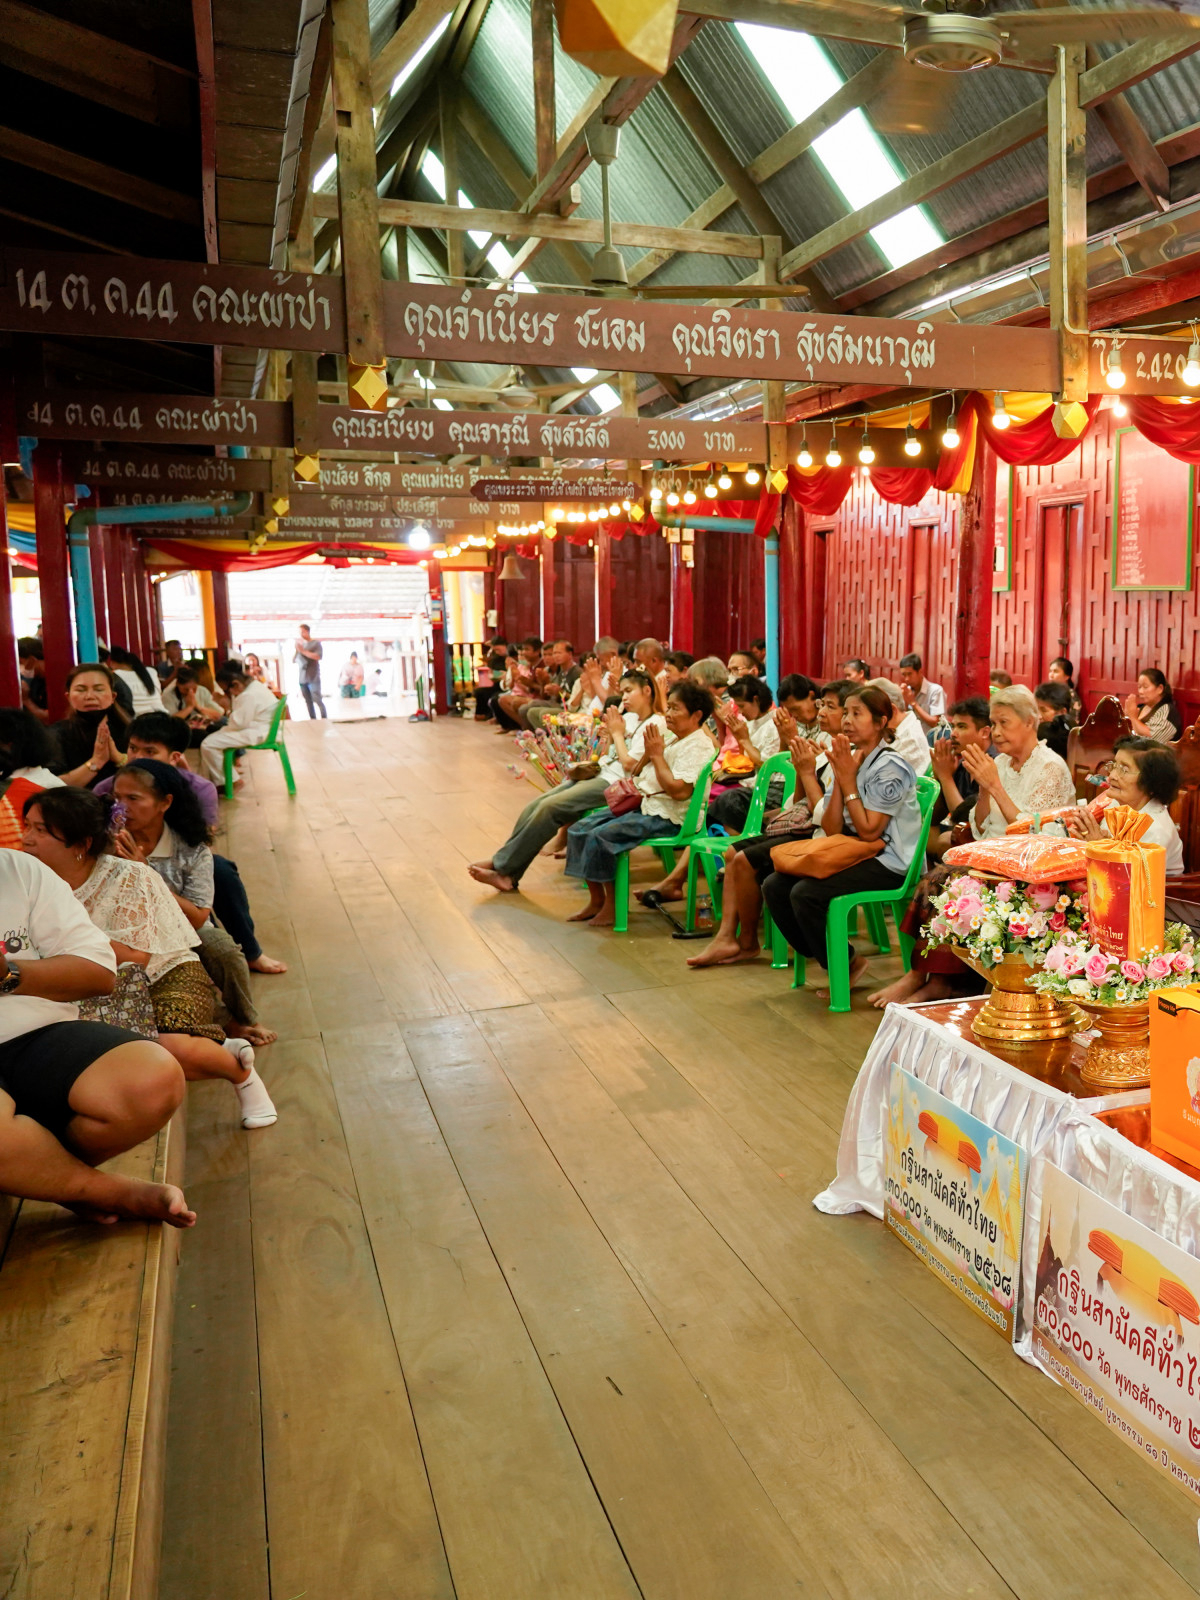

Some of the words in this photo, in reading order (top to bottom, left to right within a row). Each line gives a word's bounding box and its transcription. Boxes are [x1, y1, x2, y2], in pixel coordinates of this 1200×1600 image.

[192, 271, 332, 332] คณะผ้าป่า
[403, 289, 560, 353] คุณจำเนียร
[574, 307, 646, 353] ชะเอม
[672, 309, 781, 373] คุณจิตรา
[796, 321, 936, 386] สุขสมนาวุฒิ
[155, 398, 258, 435] คณะผ้าป่า
[332, 408, 434, 449] คุณระเบียบ
[448, 414, 530, 456] คุณจารุณี
[648, 429, 686, 451] 3,000
[168, 459, 236, 483] คณะผ้าป่า
[887, 1176, 922, 1219] ๓๐,๐๐๐
[923, 1208, 932, 1228] วัด
[933, 1220, 972, 1263] พุทธศักราช
[974, 1247, 1012, 1297] ๒๕๖๘
[900, 1147, 998, 1244] กฐินสามัคคีทั่วไทย
[1037, 1298, 1094, 1362] ๓๐,๐๐๐
[1097, 1347, 1111, 1379] วัด
[1114, 1368, 1182, 1435] พุทธศักราช
[1049, 1356, 1104, 1412] คณะศิษยานุศิษย์
[1105, 1406, 1143, 1447] บูชาธรรม
[1145, 1443, 1158, 1460] ๘๑
[1161, 1449, 1169, 1468] ปี
